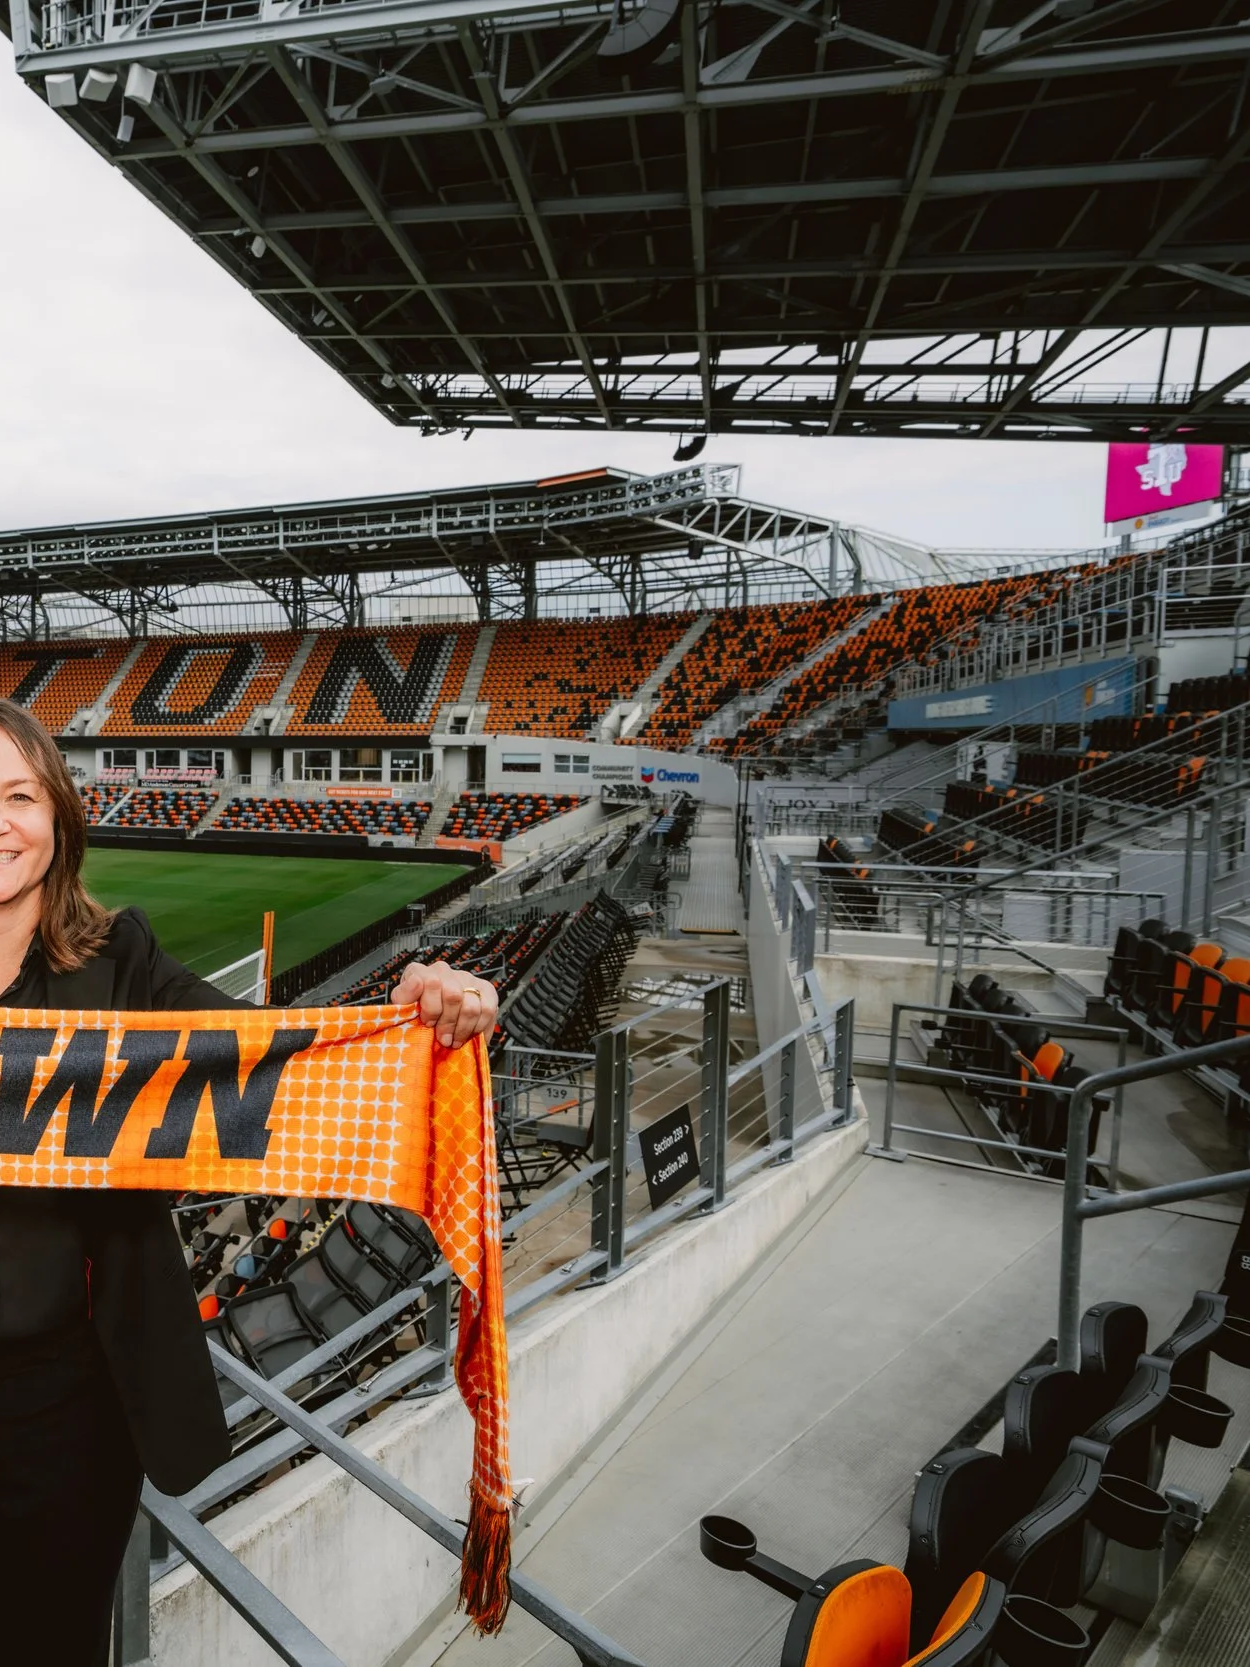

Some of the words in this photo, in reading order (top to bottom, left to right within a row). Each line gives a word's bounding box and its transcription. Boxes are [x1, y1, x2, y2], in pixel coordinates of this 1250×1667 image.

[656, 768, 700, 783] Chevron
[546, 1088, 567, 1098] 139
[653, 1135, 675, 1156] Section
[672, 1126, 684, 1143] 239
[658, 1162, 679, 1183] Section
[677, 1151, 689, 1169] 240
